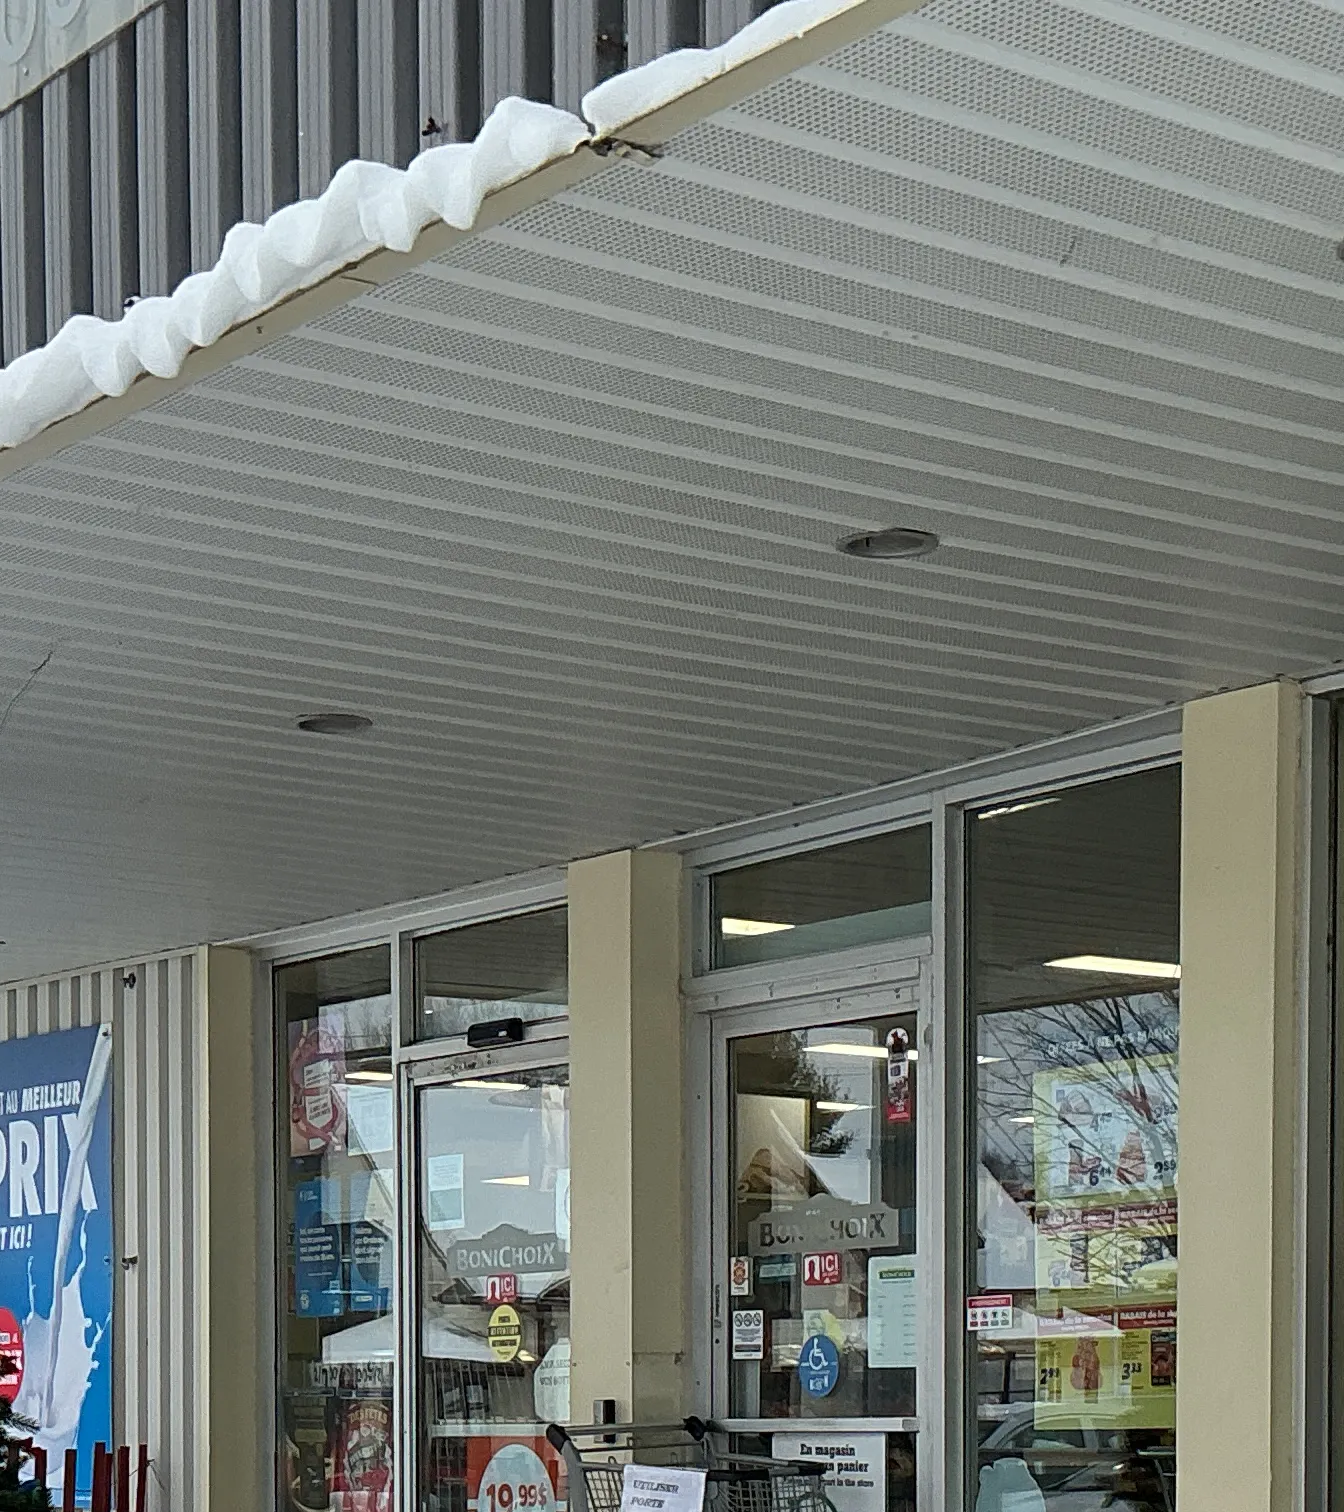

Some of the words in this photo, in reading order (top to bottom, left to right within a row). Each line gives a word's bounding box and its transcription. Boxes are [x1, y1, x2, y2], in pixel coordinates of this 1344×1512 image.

[5, 1090, 18, 1115] AU
[20, 1080, 82, 1113] MEILLEUR
[457, 1242, 556, 1271] BONICHOIX
[799, 1443, 813, 1456] En
[815, 1444, 856, 1459] magasin
[837, 1459, 870, 1475] panier
[633, 1479, 680, 1494] UTILISER
[630, 1496, 666, 1509] PORTE
